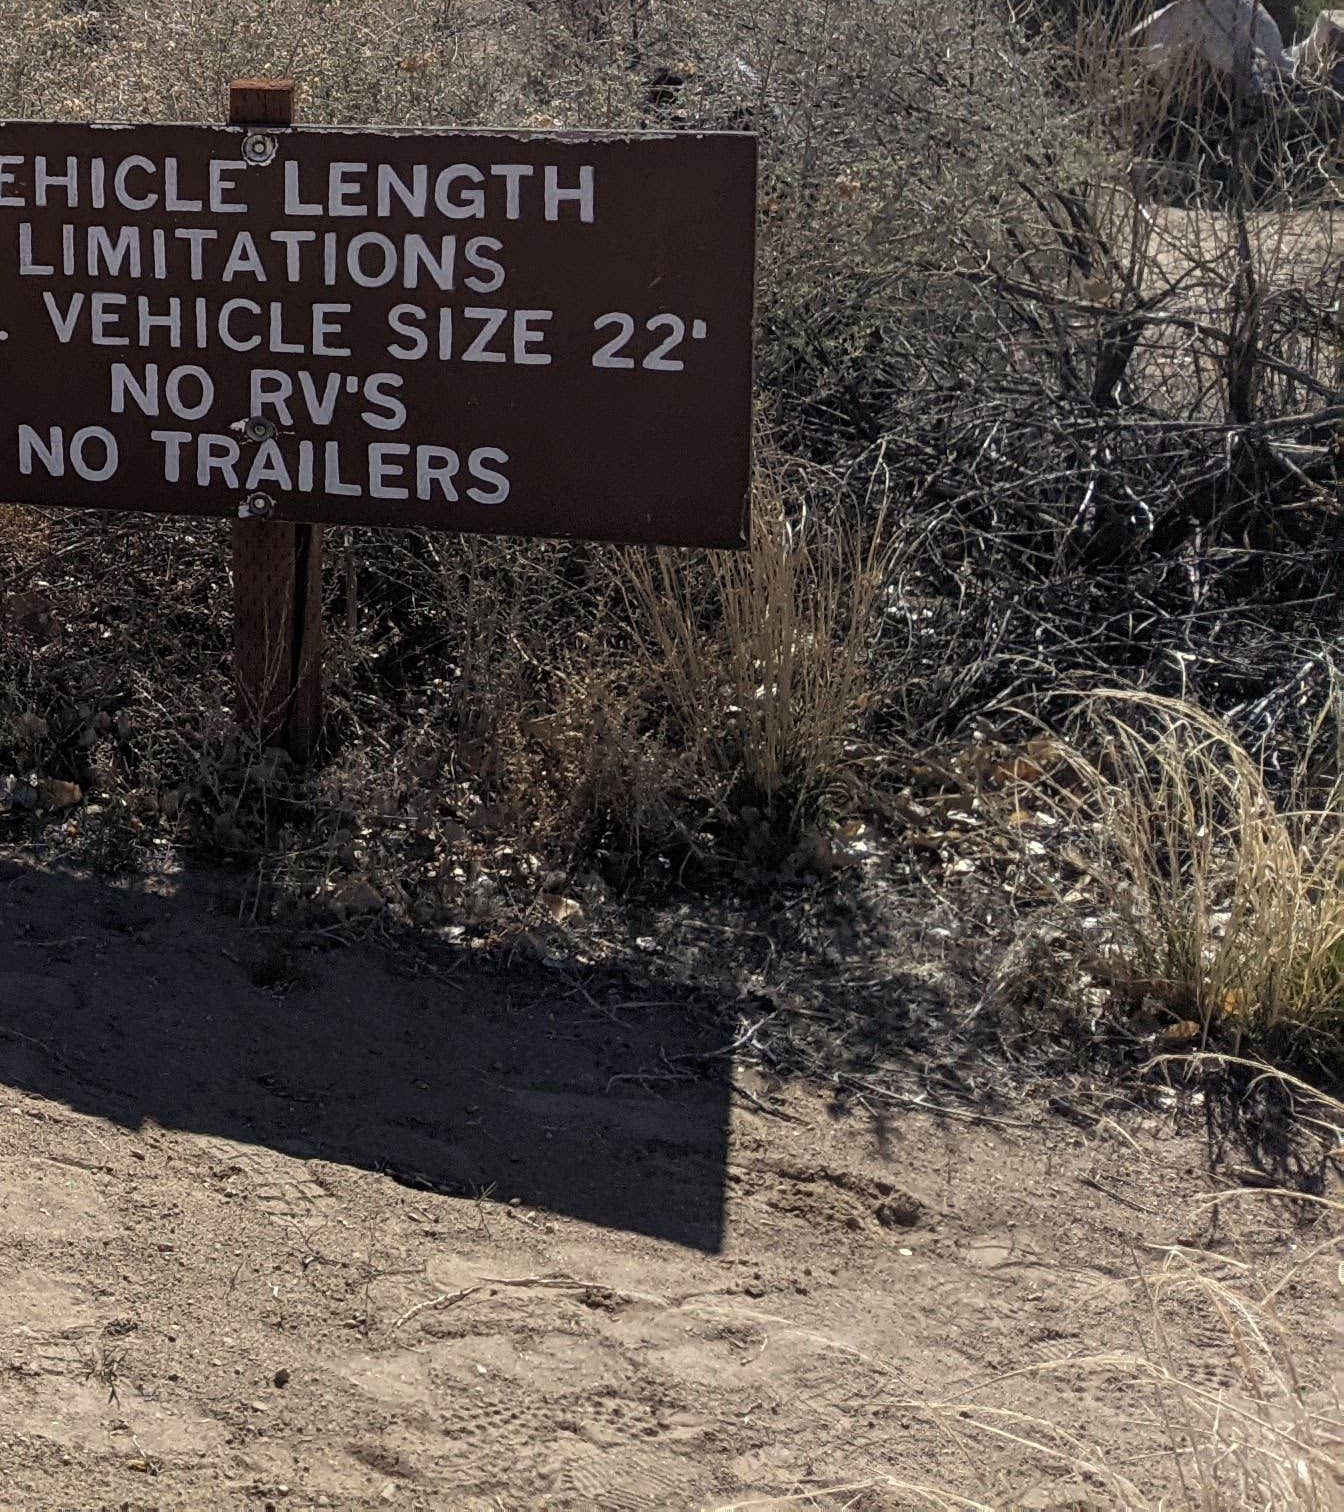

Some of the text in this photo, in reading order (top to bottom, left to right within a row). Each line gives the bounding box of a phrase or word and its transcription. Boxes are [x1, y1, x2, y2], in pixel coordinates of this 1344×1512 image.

[284, 160, 595, 224] LENGTH
[19, 222, 506, 294] LIMITATIONS
[42, 291, 352, 358] VEHICLE
[386, 303, 554, 366] SIZE
[591, 311, 708, 372] 22'
[110, 363, 408, 432] NO RV'S
[18, 424, 511, 505] NO TRAILERS
